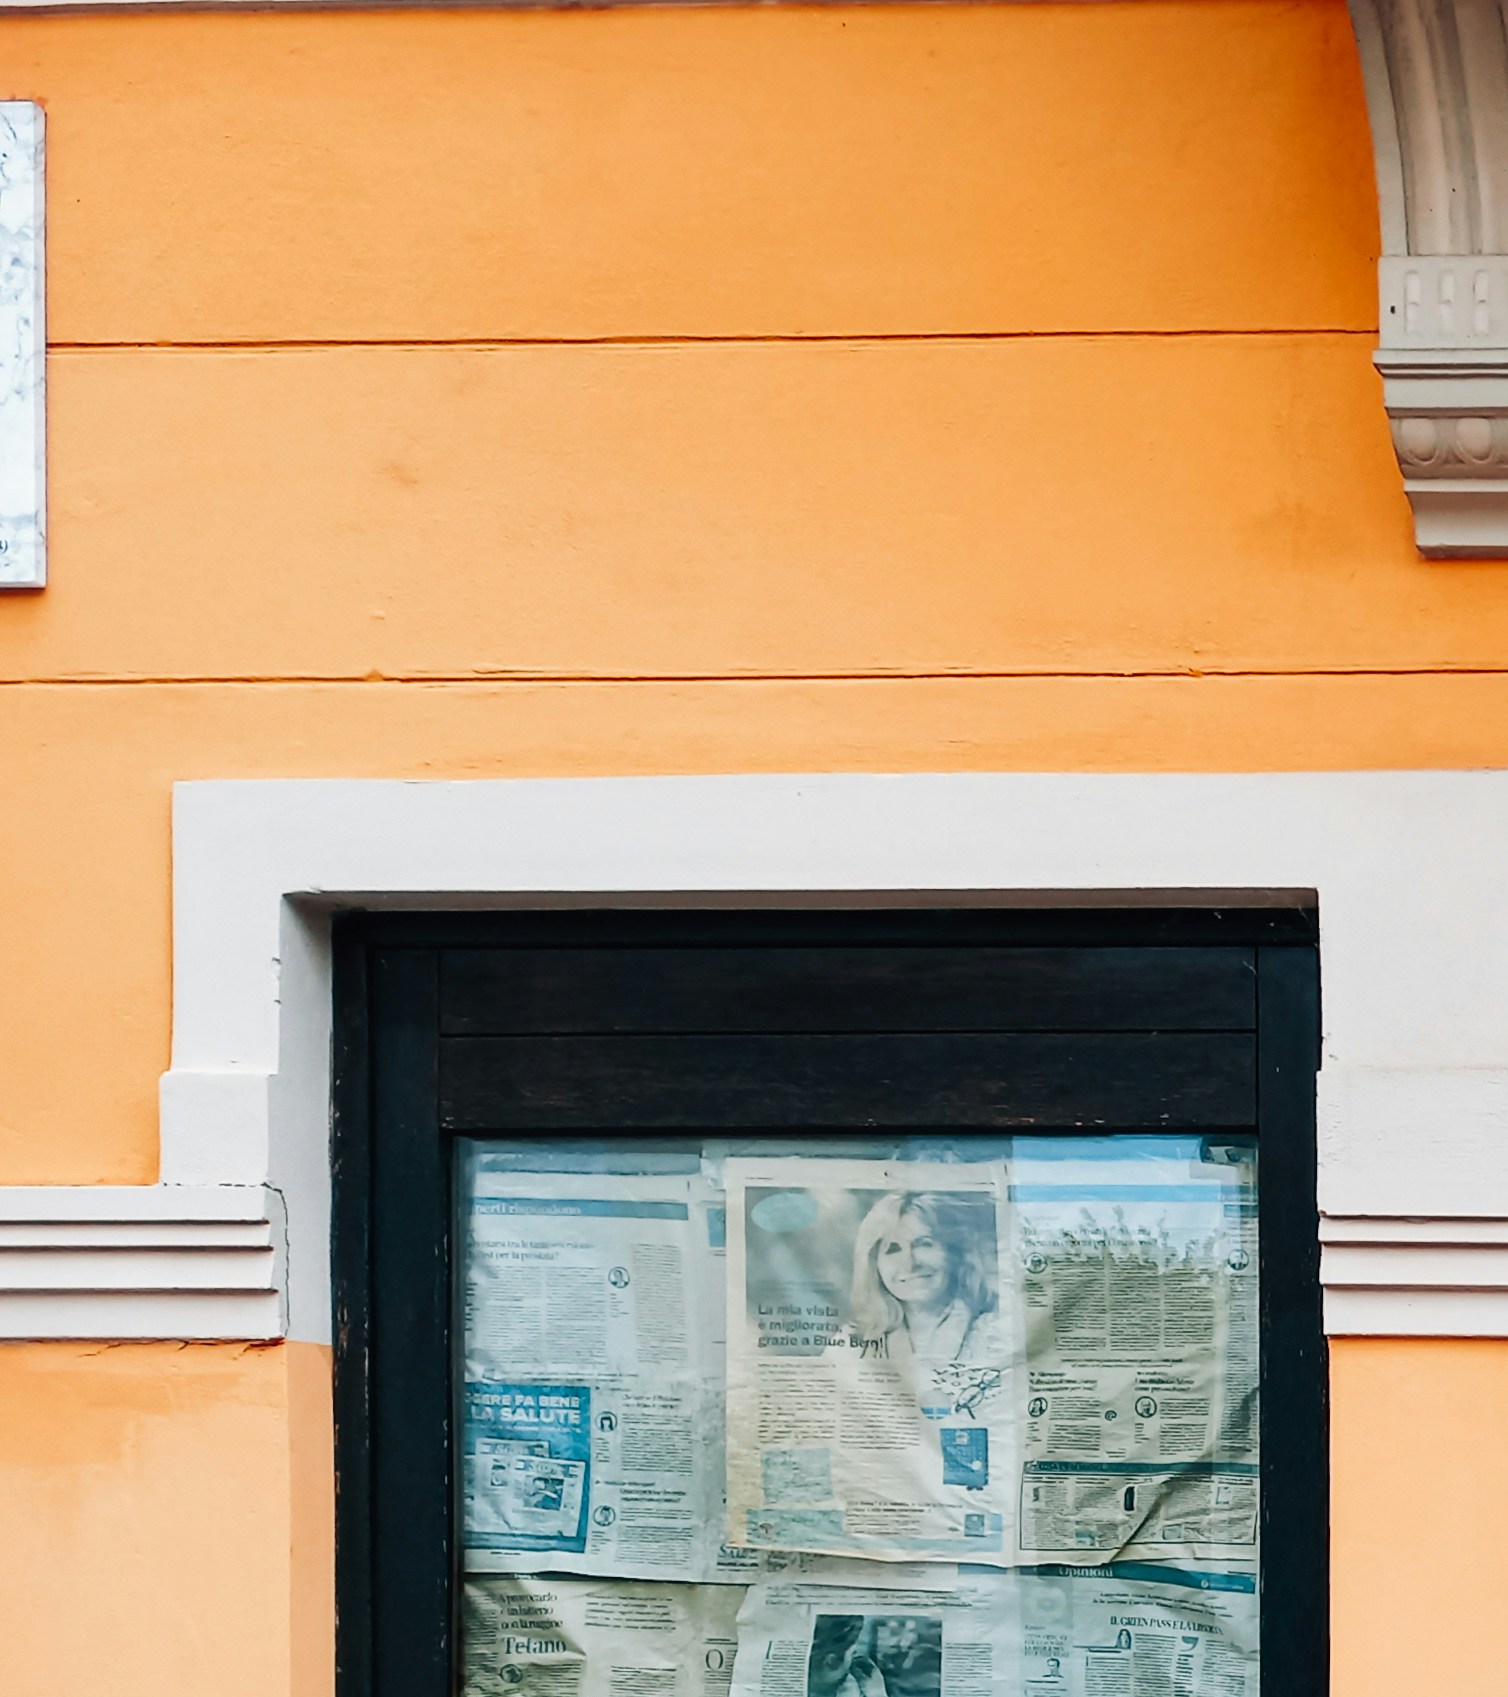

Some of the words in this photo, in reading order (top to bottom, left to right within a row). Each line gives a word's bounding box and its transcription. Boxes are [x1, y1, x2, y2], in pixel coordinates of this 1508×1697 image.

[758, 1305, 772, 1316] La
[777, 1306, 801, 1316] mia
[806, 1306, 838, 1317] vista
[758, 1336, 797, 1348] grazie
[802, 1338, 810, 1346] a
[814, 1336, 844, 1347] Blue
[501, 1409, 581, 1424] SALUTE
[504, 1637, 567, 1654] Tetano
